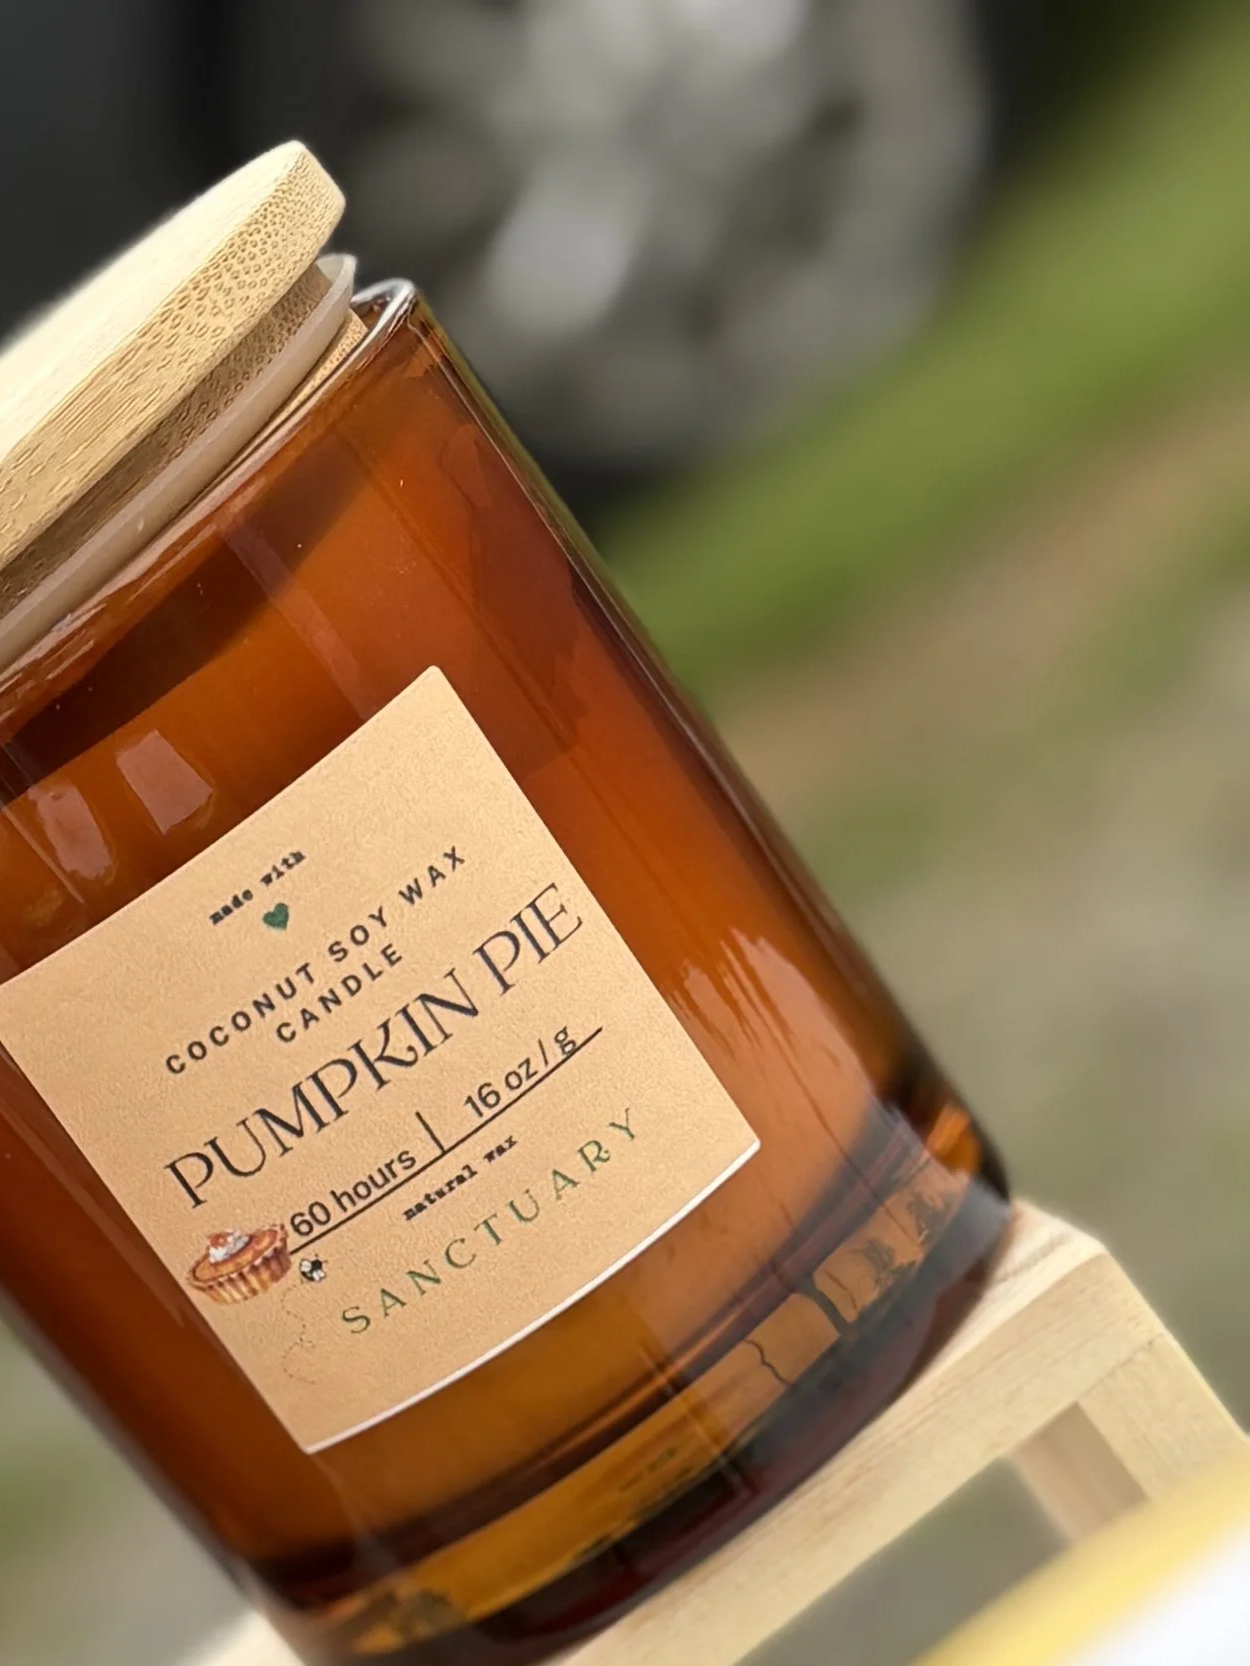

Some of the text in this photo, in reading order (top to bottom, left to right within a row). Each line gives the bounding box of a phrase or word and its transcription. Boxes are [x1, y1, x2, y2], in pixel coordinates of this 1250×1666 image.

[166, 846, 465, 1074] COCONUT SOY WAX
[208, 851, 306, 927] made with
[163, 882, 583, 1208] PUMPKIN PIE
[276, 943, 402, 1043] CANDLE
[290, 1201, 331, 1236] 60
[330, 1150, 416, 1212] hours
[464, 1082, 501, 1118] 16
[341, 1107, 636, 1334] SANCTUARY
[403, 1135, 518, 1221] natural wax
